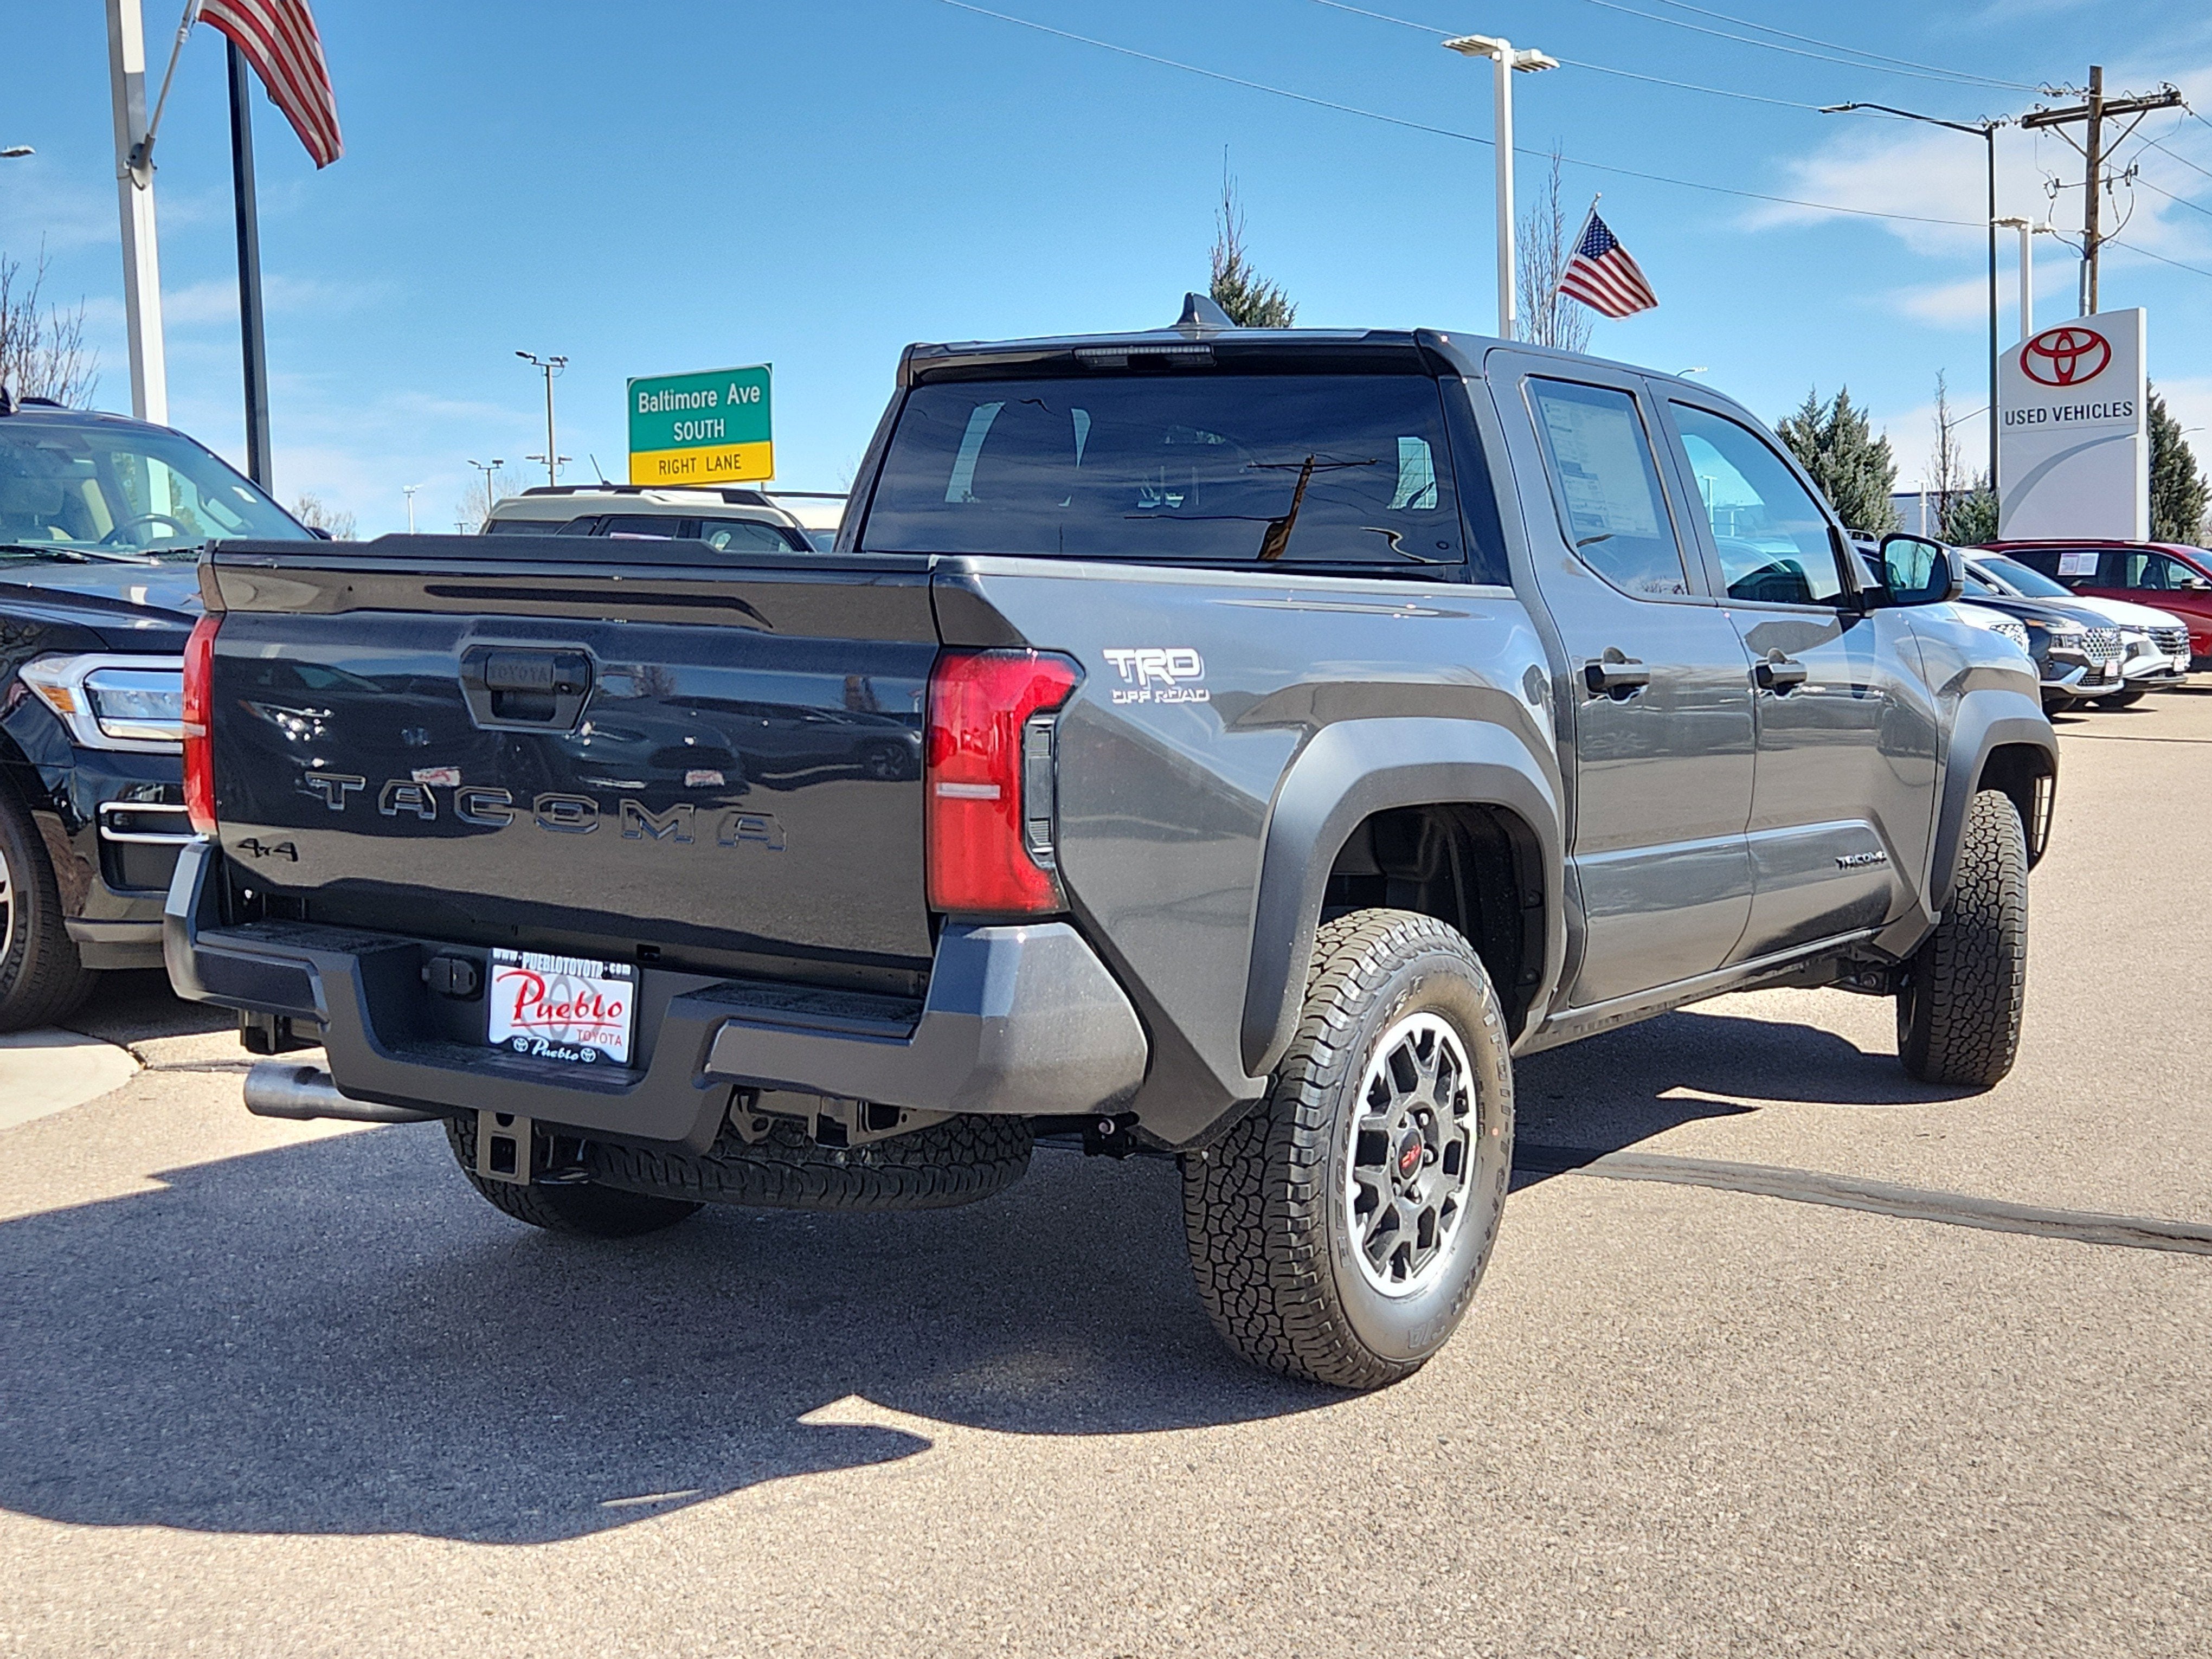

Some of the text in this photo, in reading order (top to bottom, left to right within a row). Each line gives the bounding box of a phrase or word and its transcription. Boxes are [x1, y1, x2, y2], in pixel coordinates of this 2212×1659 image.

[638, 383, 761, 414] Baltimore Ave
[2005, 401, 2133, 426] USED VEHICLES
[673, 418, 725, 441] SOUTH
[659, 454, 742, 475] RIGHT LANE
[488, 663, 549, 683] TOYOTA
[1103, 648, 1203, 687] TRD
[1111, 688, 1211, 704] OFF ROAD
[304, 770, 787, 852] TACOMA
[496, 969, 622, 1020] Pueblo
[528, 1036, 580, 1061] Pueblo
[577, 1029, 622, 1047] TOYOTA
